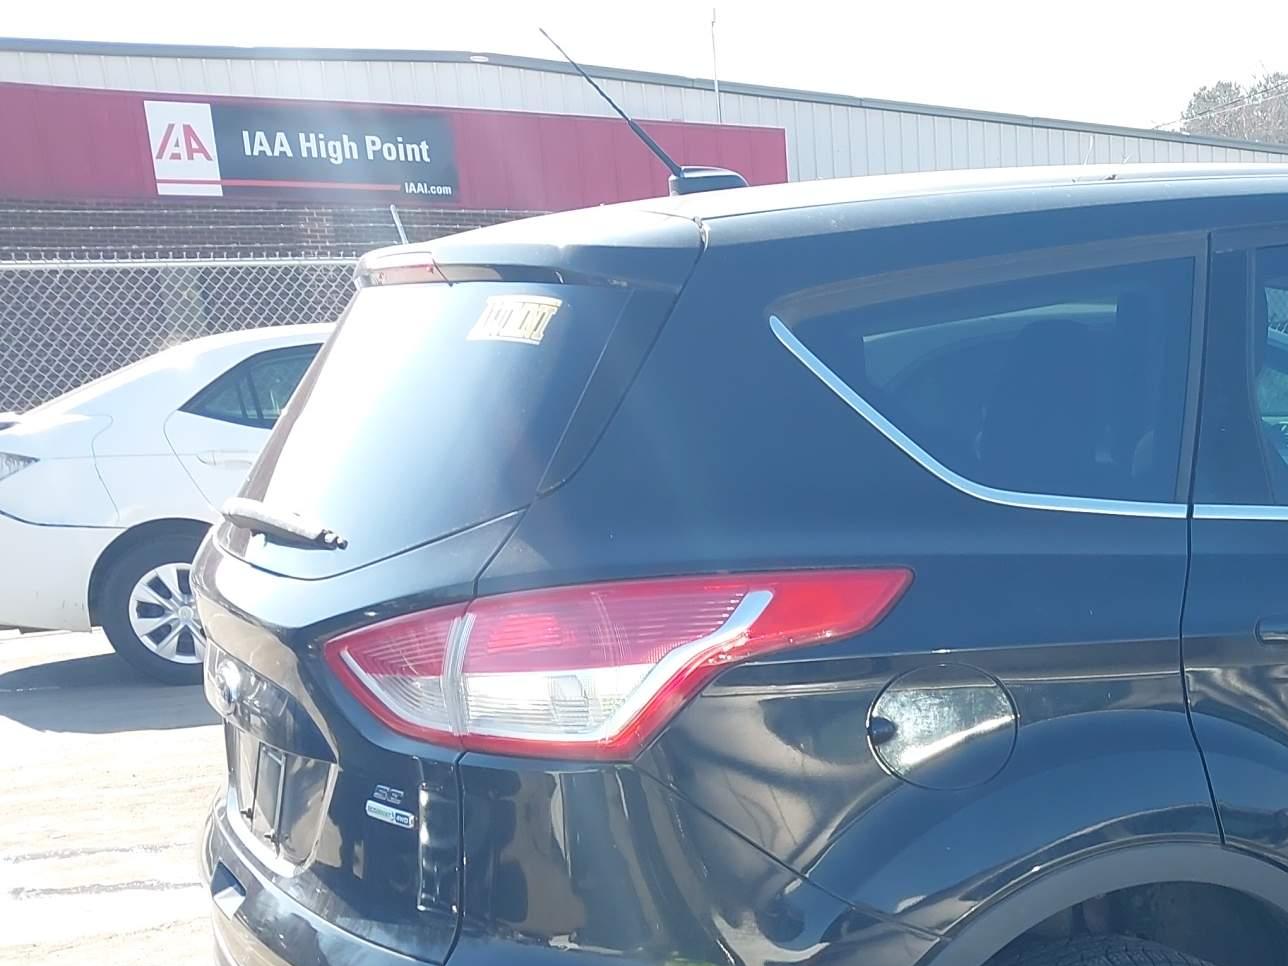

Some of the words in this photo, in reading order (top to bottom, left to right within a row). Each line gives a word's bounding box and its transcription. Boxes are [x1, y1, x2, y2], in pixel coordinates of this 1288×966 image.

[242, 130, 293, 157] IAA
[299, 132, 359, 165] High
[364, 135, 431, 162] Point
[404, 182, 452, 195] IAAI.com
